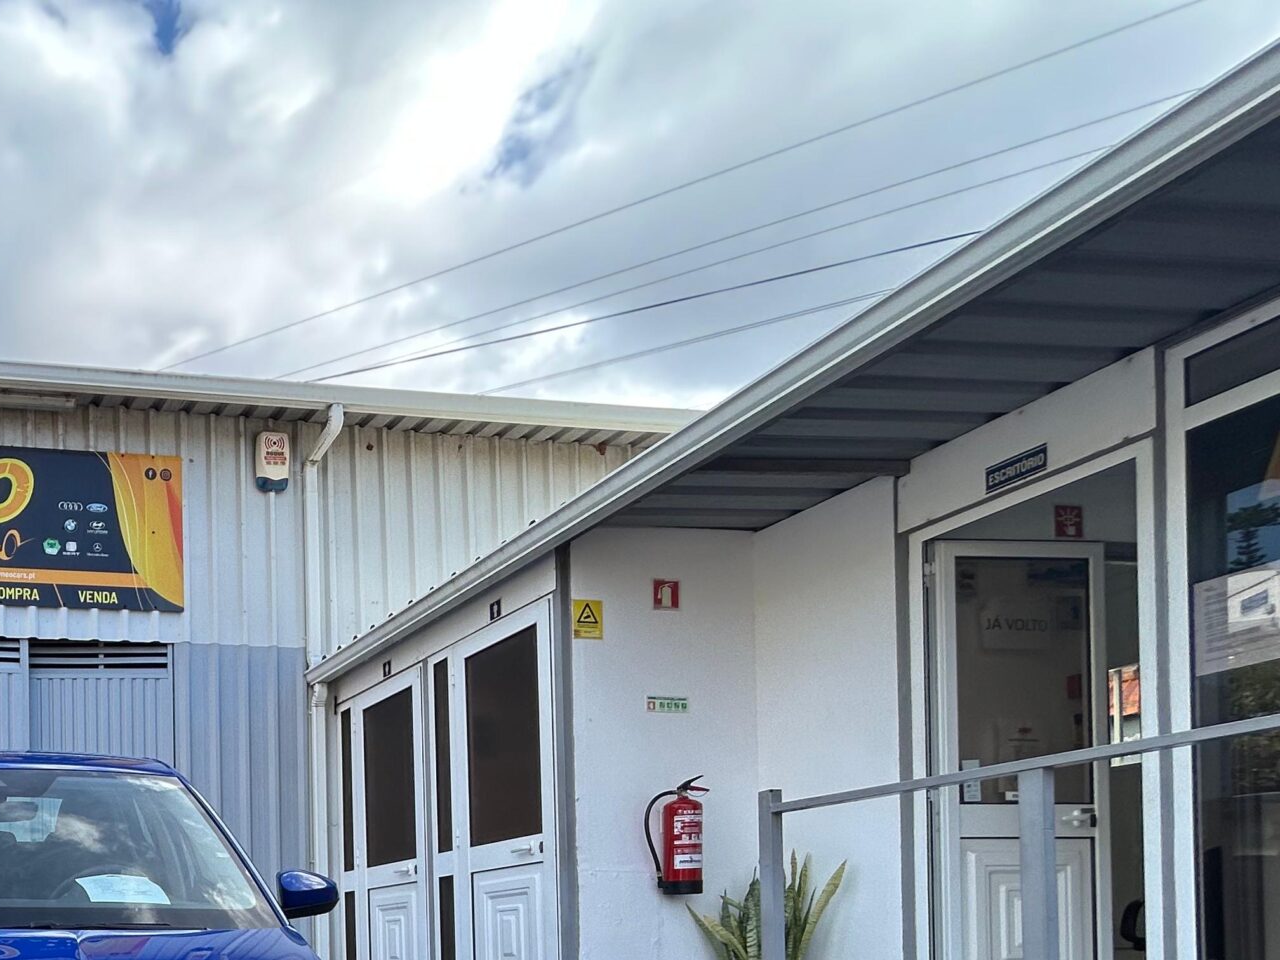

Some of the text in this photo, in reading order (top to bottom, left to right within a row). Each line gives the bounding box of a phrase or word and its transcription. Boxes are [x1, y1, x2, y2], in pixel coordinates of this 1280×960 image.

[988, 453, 1046, 486] ESCRITÓRIO
[78, 590, 119, 604] VENDA
[985, 615, 1048, 632] JÁ VOLTO
